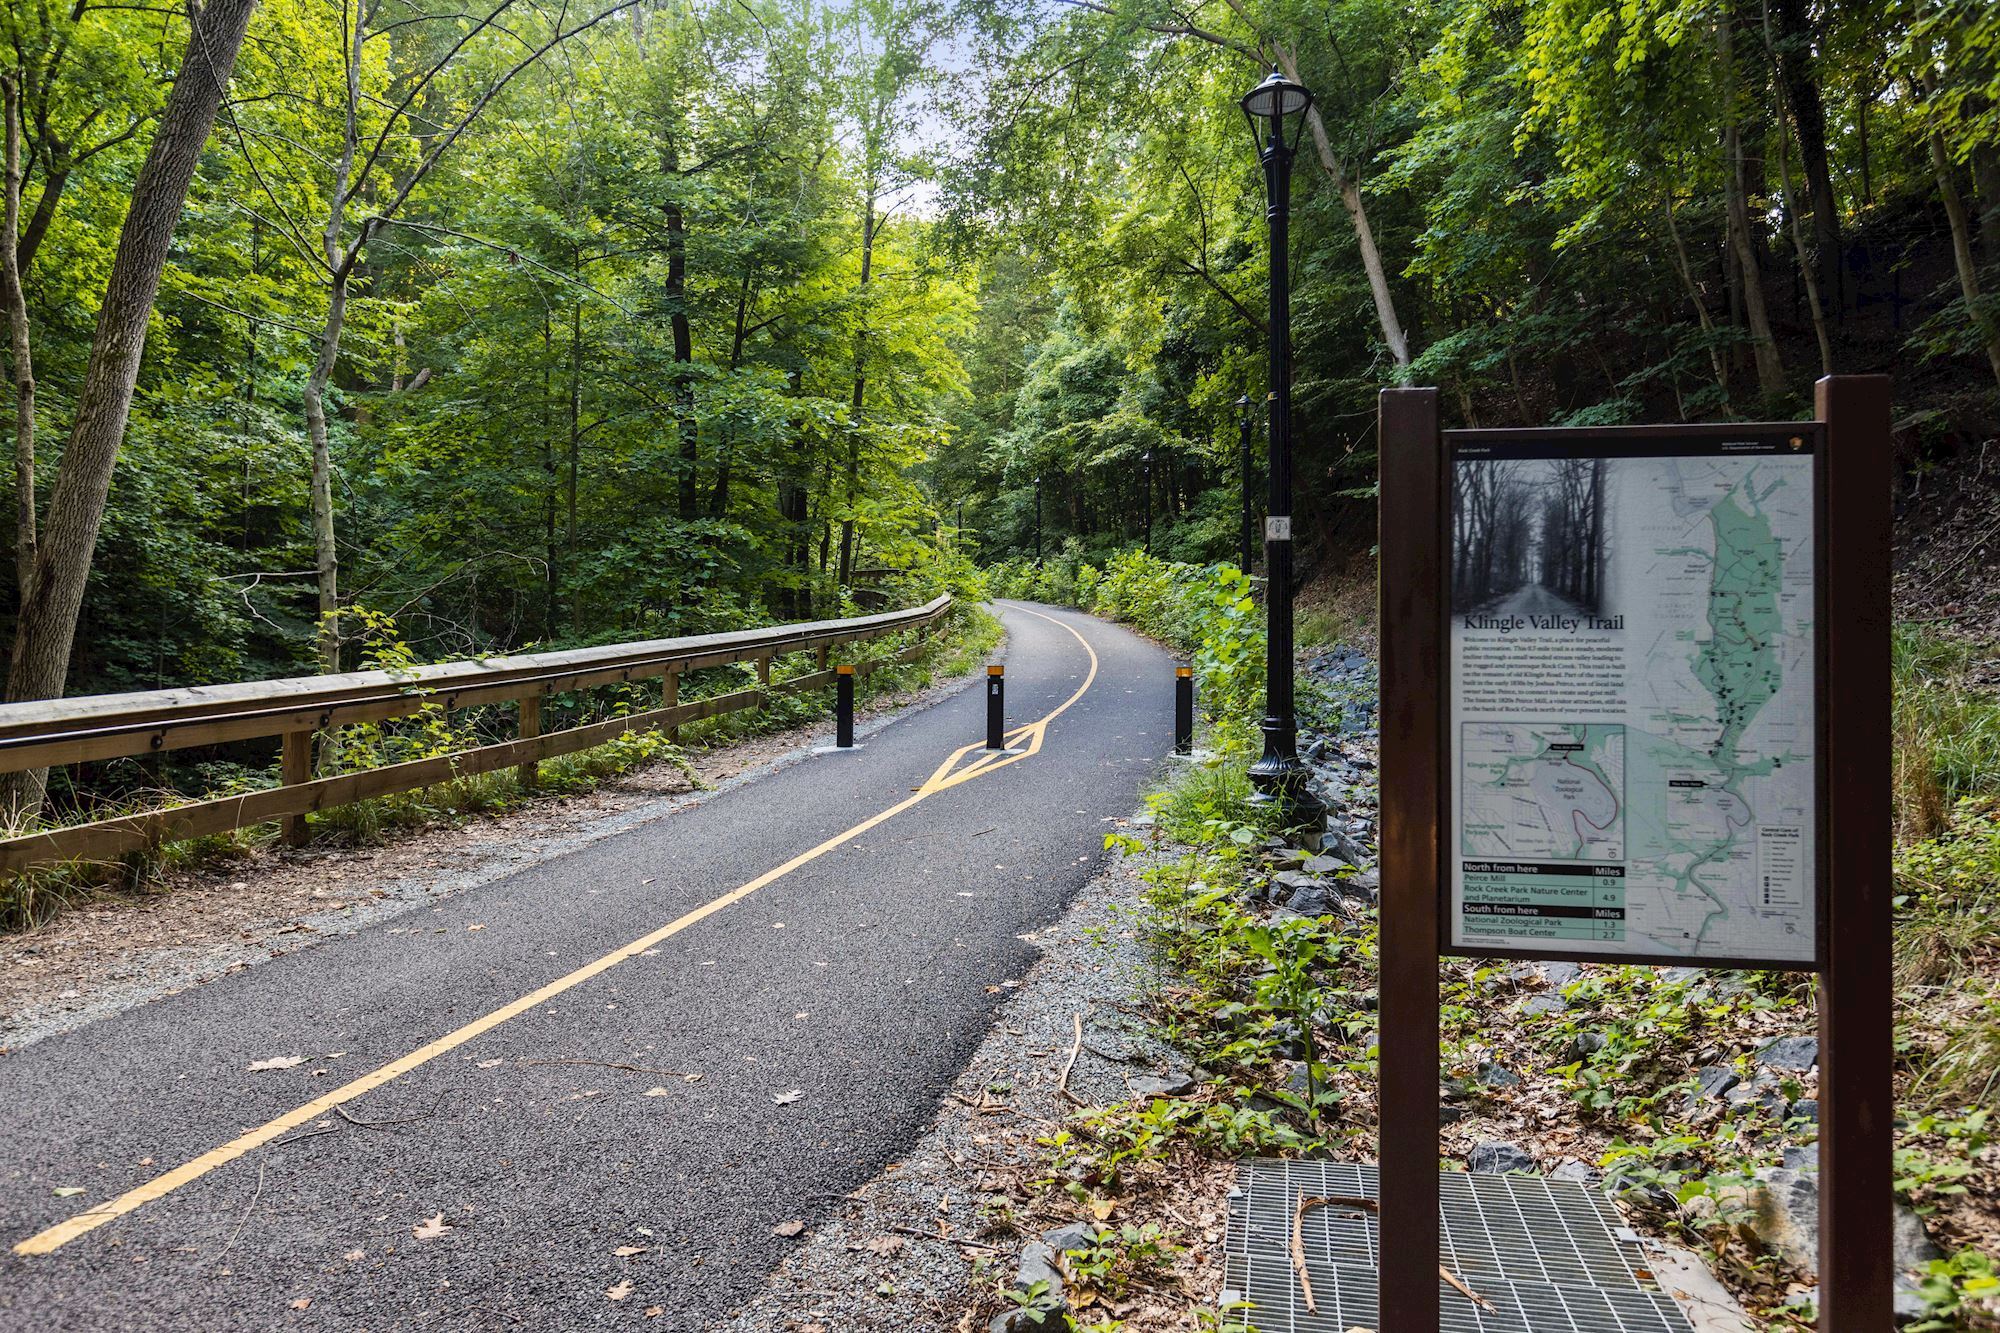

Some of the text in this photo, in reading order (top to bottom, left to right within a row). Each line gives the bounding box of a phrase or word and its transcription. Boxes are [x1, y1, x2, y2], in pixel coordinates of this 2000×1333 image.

[1464, 614, 1624, 633] Klingle Valley Trail
[1464, 863, 1538, 873] North from here
[1596, 867, 1620, 876] Miles
[1482, 894, 1530, 902] Planetarium
[1464, 904, 1538, 915] South from here
[1596, 909, 1620, 918] Miles
[1465, 916, 1498, 924] National
[1501, 917, 1542, 927] Zoological
[1465, 926, 1505, 935] Thompson
